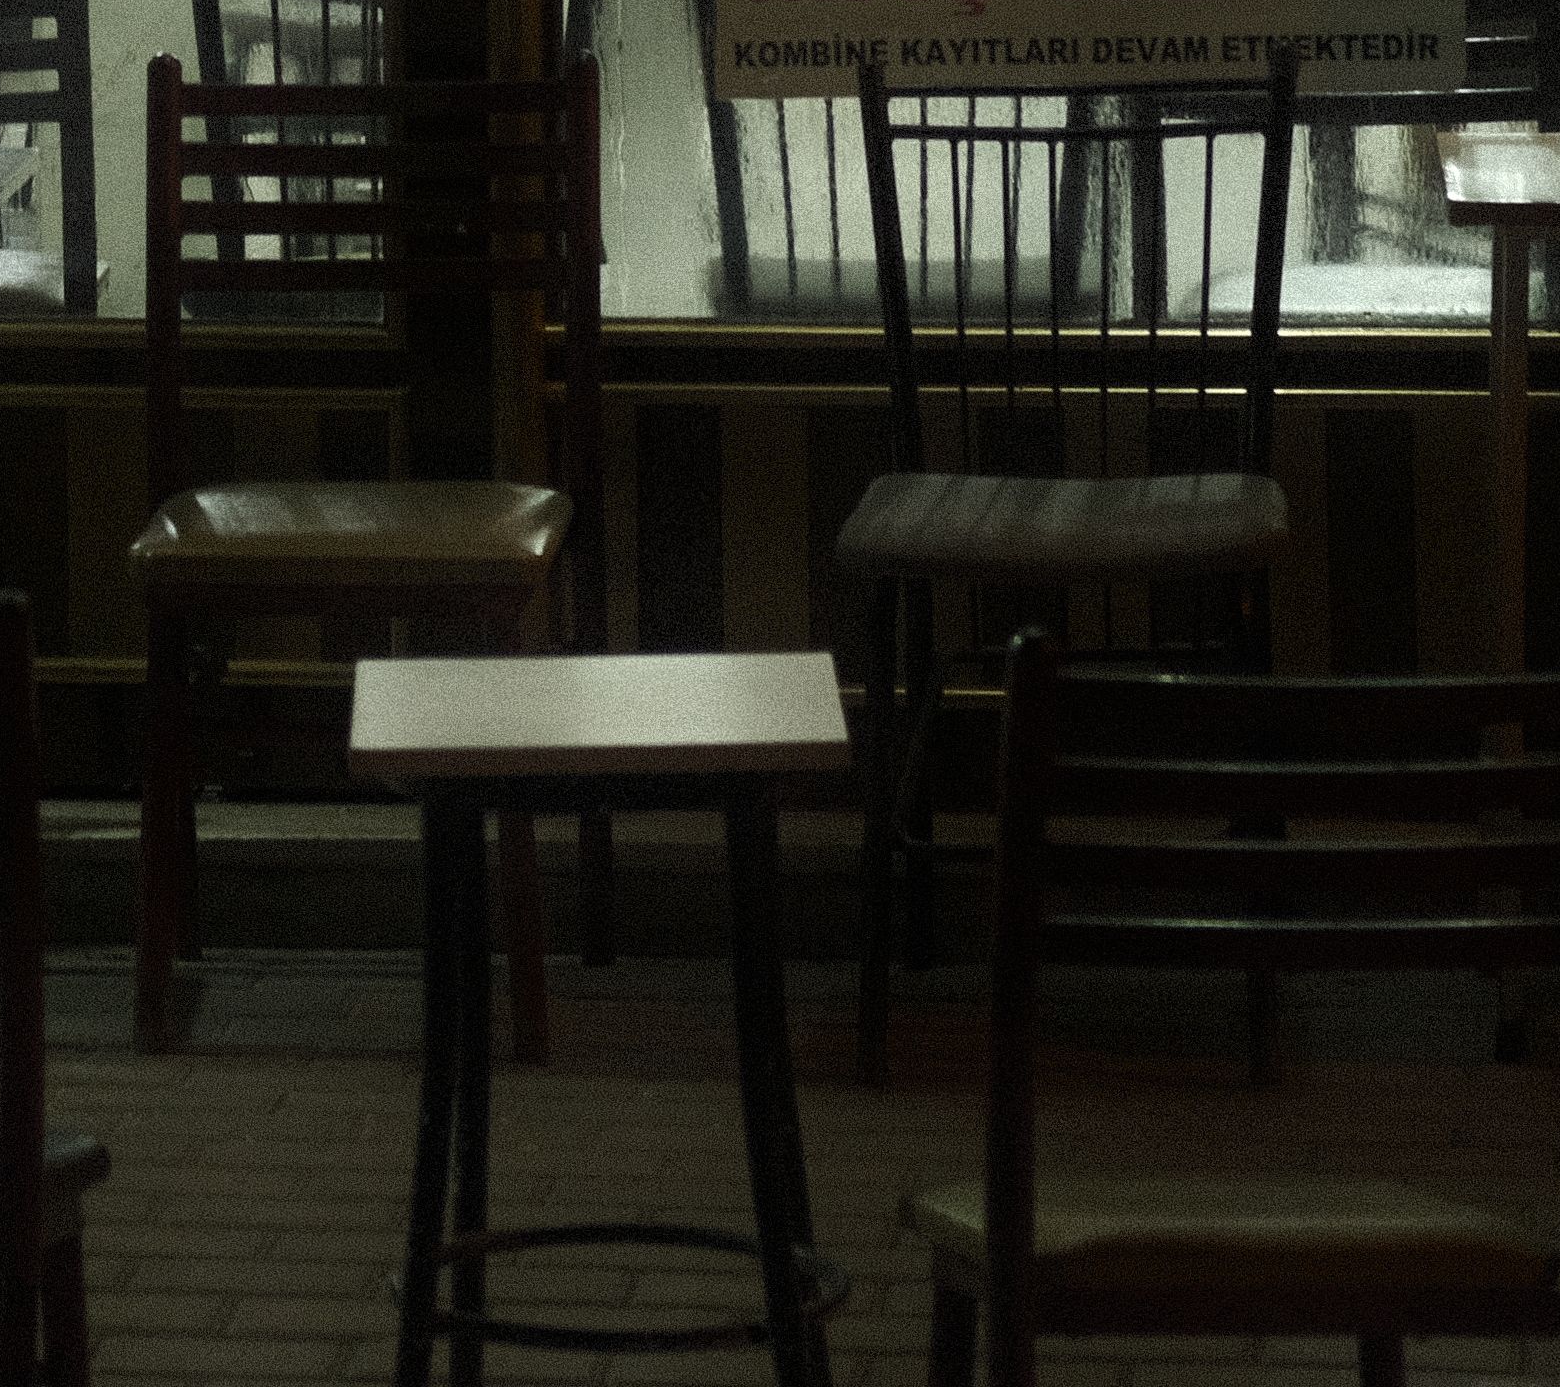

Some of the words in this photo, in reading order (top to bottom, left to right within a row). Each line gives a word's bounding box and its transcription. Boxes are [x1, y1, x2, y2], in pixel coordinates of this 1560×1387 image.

[733, 32, 888, 70] KOMBİNE
[901, 35, 1080, 66] KAYITLARI
[1091, 34, 1211, 64] DEVAM
